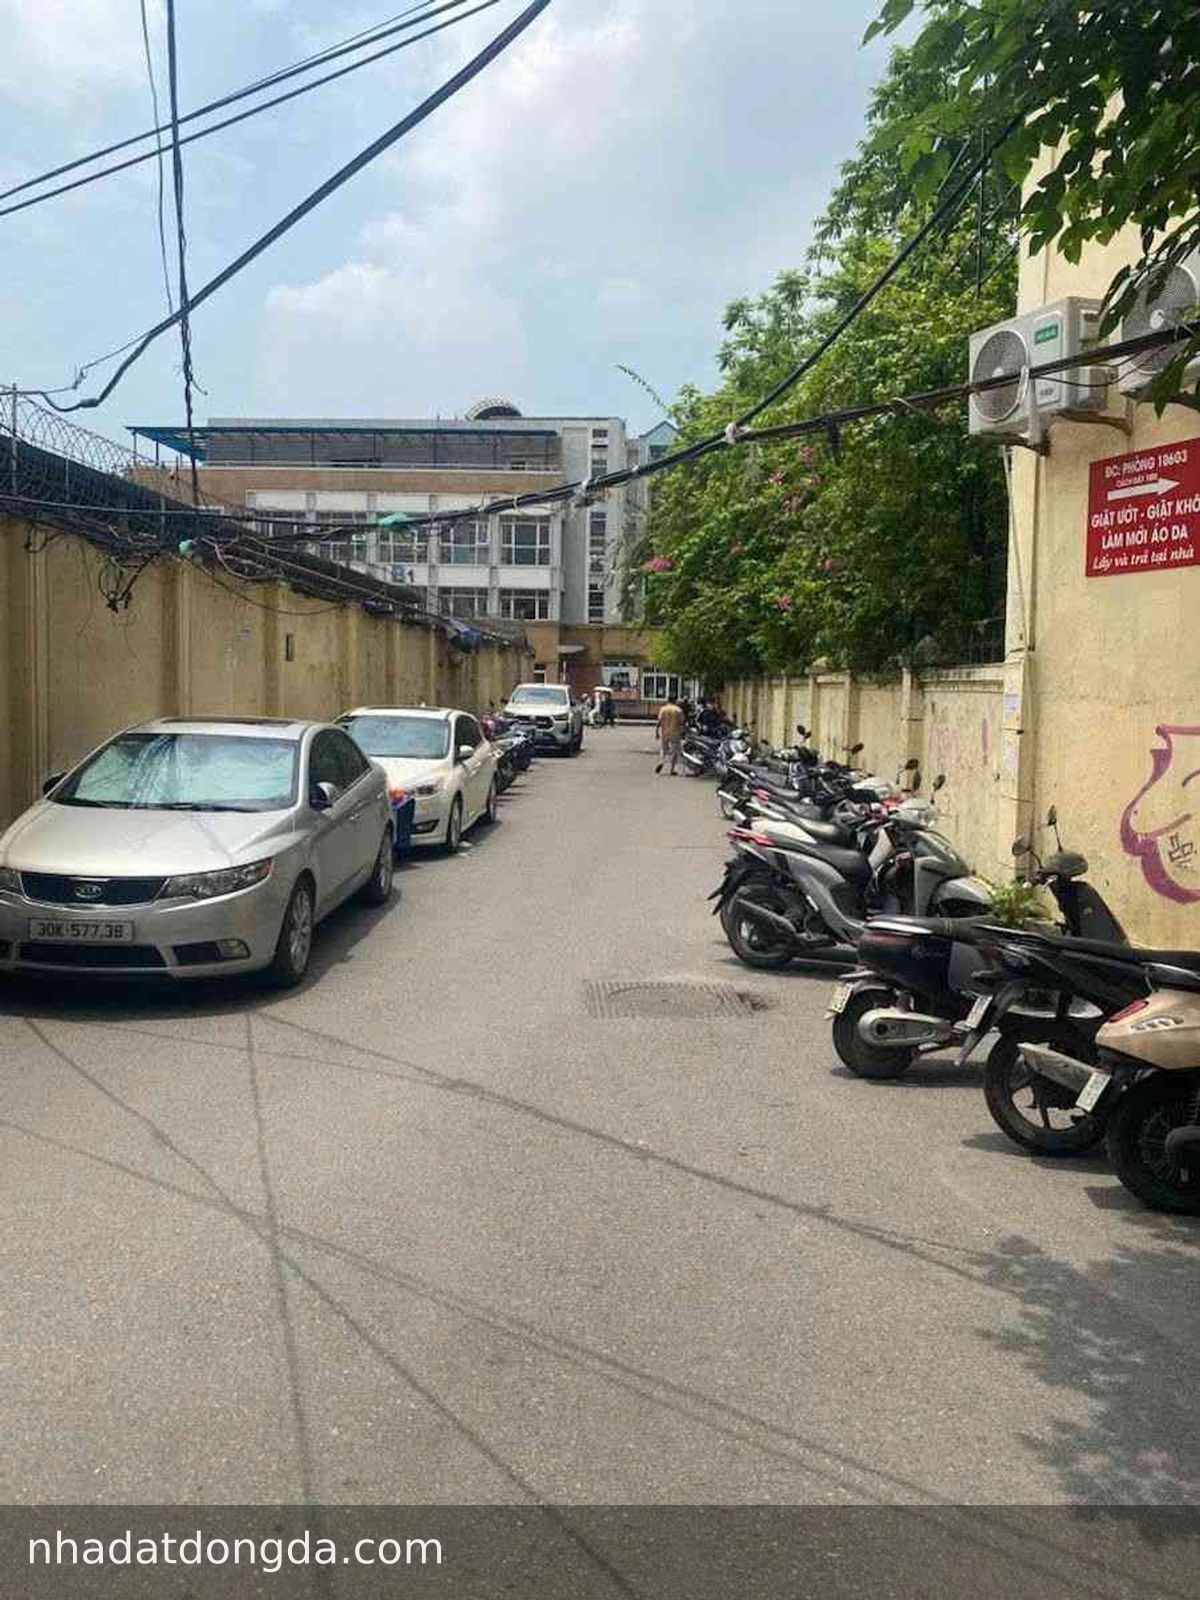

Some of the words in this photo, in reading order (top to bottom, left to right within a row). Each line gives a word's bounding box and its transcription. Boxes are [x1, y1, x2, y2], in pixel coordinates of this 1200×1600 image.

[1147, 499, 1173, 522] GIẶT
[1101, 530, 1123, 549] LÀM
[1125, 525, 1147, 547] MỚI
[1151, 522, 1169, 544] ÁO
[1171, 524, 1188, 540] DA
